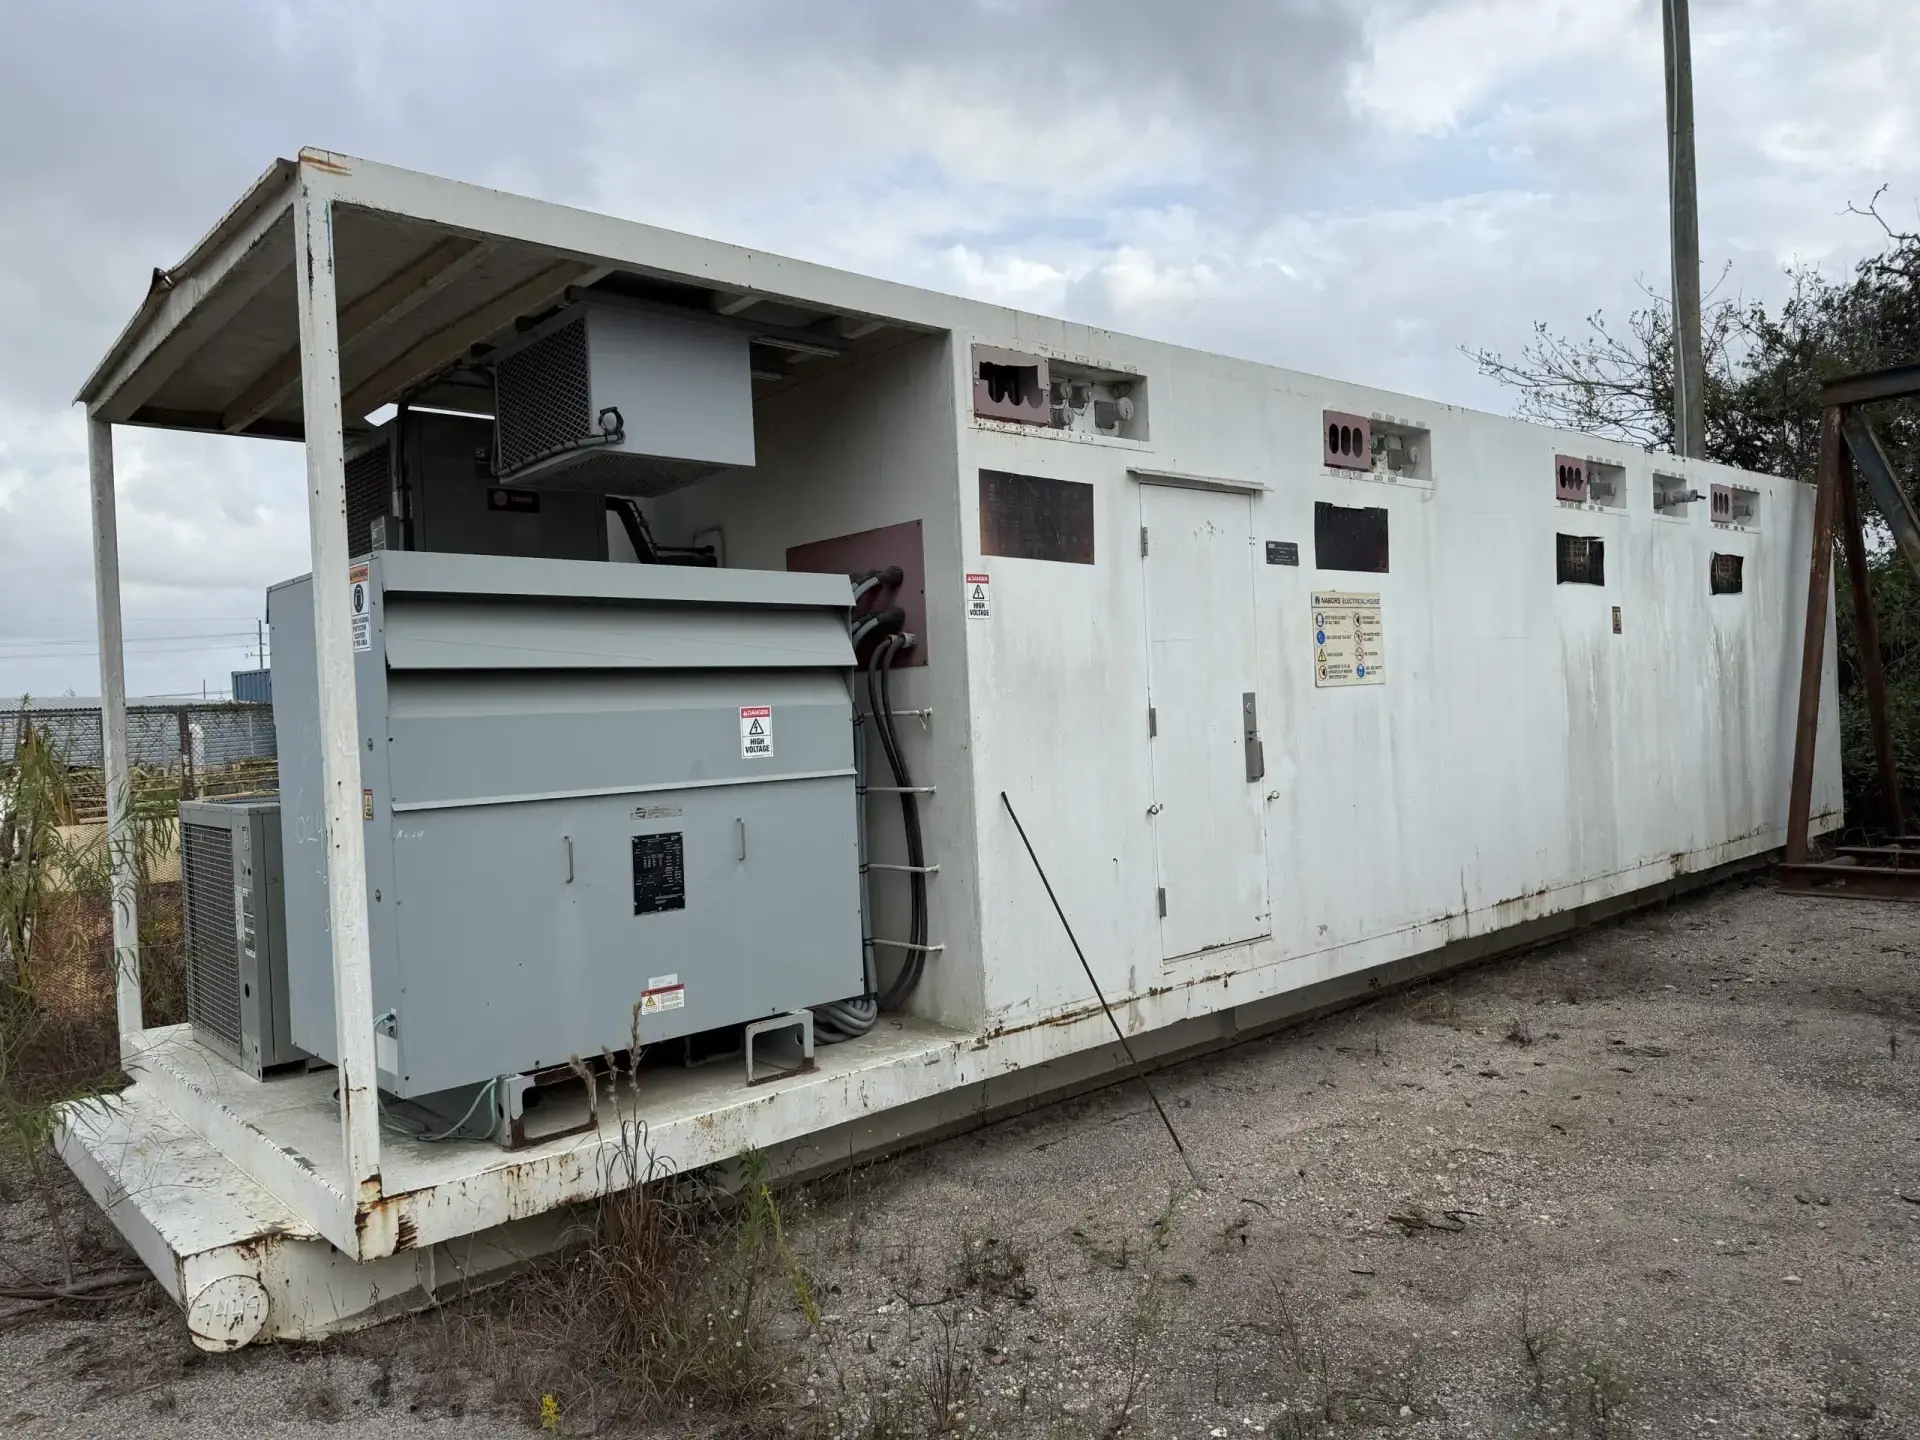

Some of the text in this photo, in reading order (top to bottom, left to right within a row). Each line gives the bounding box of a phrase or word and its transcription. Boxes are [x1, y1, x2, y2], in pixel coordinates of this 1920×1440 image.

[1321, 596, 1341, 605] NABORS
[750, 737, 765, 745] HIGH
[745, 744, 770, 753] VOLTAGE
[198, 1295, 260, 1335] 7449
